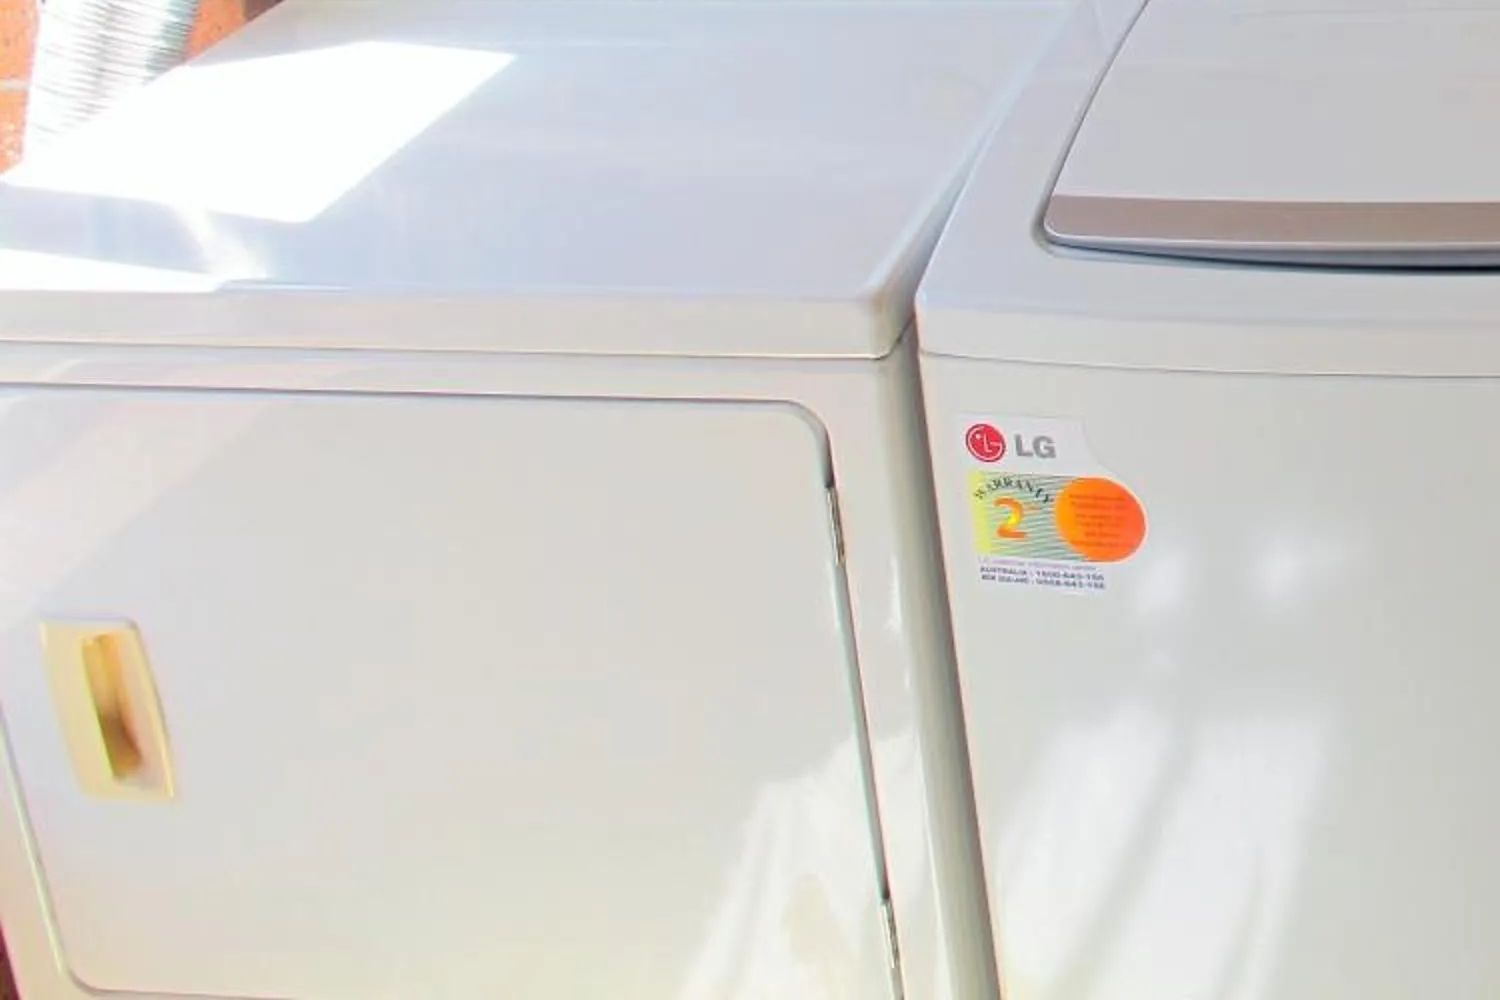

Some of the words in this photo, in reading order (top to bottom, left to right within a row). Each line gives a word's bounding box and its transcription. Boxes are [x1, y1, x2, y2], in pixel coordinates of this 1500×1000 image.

[1014, 432, 1057, 458] LG
[973, 477, 1054, 503] WARRANTY
[992, 496, 1027, 540] 2
